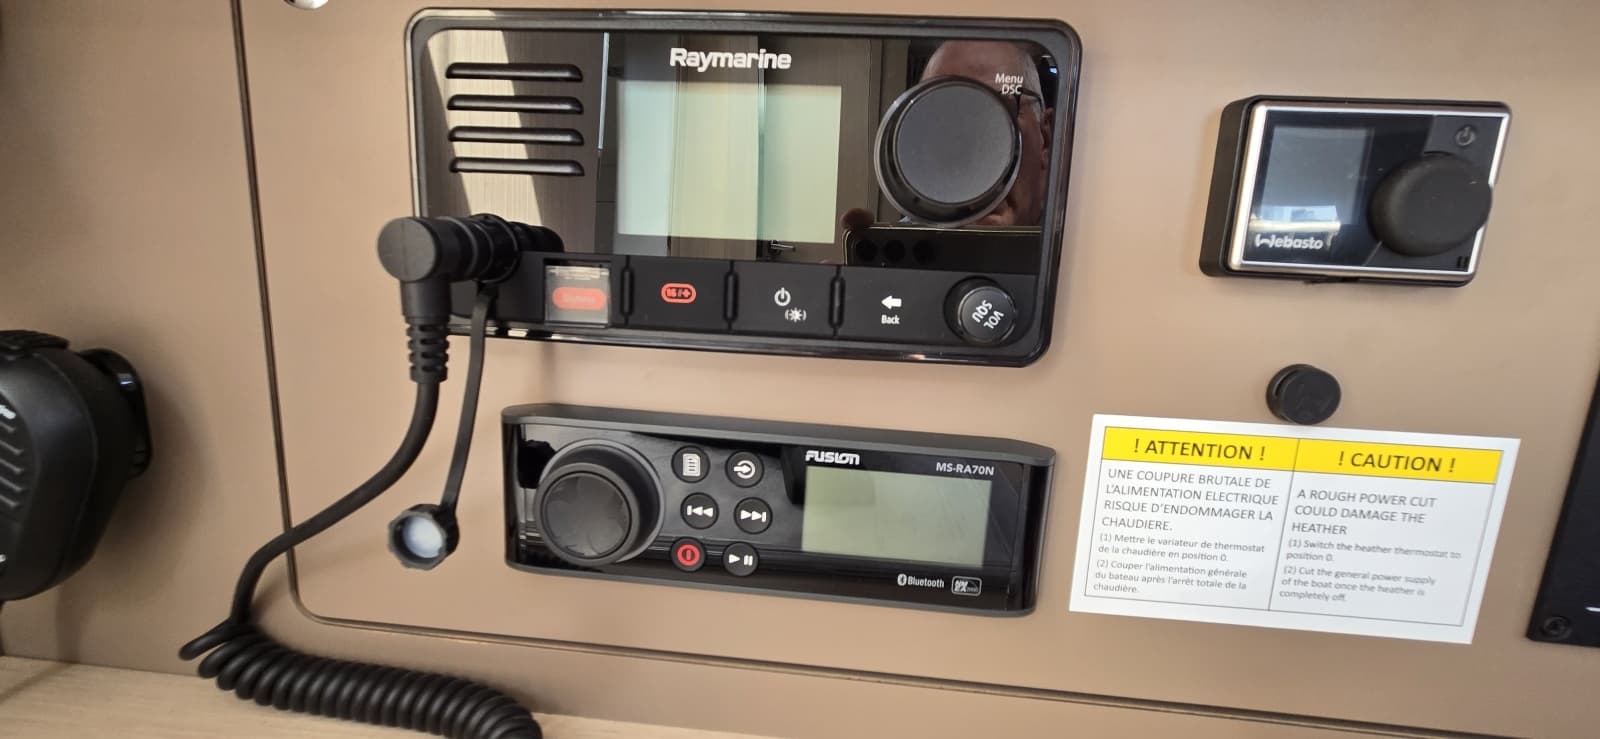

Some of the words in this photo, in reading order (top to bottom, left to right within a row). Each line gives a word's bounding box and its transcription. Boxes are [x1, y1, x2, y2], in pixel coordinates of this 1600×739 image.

[670, 47, 792, 72] Raymarine
[995, 73, 1024, 84] Menu
[1002, 84, 1022, 94] DSC
[1255, 234, 1323, 249] Webasto
[881, 314, 900, 324] Back
[972, 300, 993, 323] SQU
[984, 310, 1005, 329] VOL
[805, 450, 860, 465] FUSION
[1134, 438, 1139, 453] !
[1145, 440, 1253, 460] ATTENTION
[1259, 446, 1266, 461] !
[936, 462, 994, 476] MS-RA70N
[1338, 451, 1345, 466] !
[1350, 452, 1442, 472] CAUTION
[1448, 458, 1456, 473] !
[1108, 469, 1132, 479] UNE
[1137, 470, 1195, 483] COUPURE
[1199, 474, 1251, 487] BRUTALE
[1255, 478, 1271, 488] DE
[1106, 484, 1202, 500] L'ALIMENTATION
[1205, 491, 1279, 506] ELECTRIQUE
[1297, 489, 1306, 498] A
[1310, 490, 1356, 502] ROUGH
[1359, 493, 1406, 506] POWER
[1409, 496, 1437, 508] CUT
[1104, 500, 1147, 513] RISQUE
[1151, 503, 1256, 519] D'ENDOMMAGER
[1259, 511, 1273, 521] LA
[1295, 505, 1337, 518] COULD
[1341, 508, 1397, 521] DAMAGE
[1402, 512, 1426, 524] THE
[1102, 517, 1173, 531] CHAUDIERE.
[1291, 522, 1347, 535] HEATHER
[1100, 533, 1112, 542] (1)
[1114, 534, 1145, 544] Mettre
[1148, 537, 1155, 545] le
[1158, 538, 1198, 548] variateur
[1215, 542, 1265, 552] thermostat
[1289, 539, 1301, 548] (1)
[1304, 540, 1334, 550] Switch
[1337, 542, 1352, 551] the
[1354, 544, 1392, 554] heather
[1394, 547, 1448, 558] thermostat
[1122, 546, 1166, 558] chaudière
[1182, 551, 1218, 561] position
[1286, 552, 1324, 562] position
[1097, 560, 1109, 568] (2)
[1111, 560, 1143, 571] Couper
[1208, 568, 1247, 578] générale
[1284, 566, 1297, 575] (2)
[1299, 566, 1315, 576] Cut
[1317, 568, 1333, 577] the
[1334, 570, 1370, 580] general
[1371, 573, 1402, 583] power
[1404, 576, 1436, 586] supply
[908, 576, 944, 588] Bluetooth
[1093, 583, 1139, 593] chaudière.
[1109, 572, 1139, 582] bateau
[1142, 574, 1165, 586] après
[1196, 579, 1222, 588] totale
[1225, 580, 1237, 589] de
[1239, 582, 1247, 590] la
[1293, 579, 1309, 587] the
[1312, 580, 1332, 589] boat
[1360, 584, 1375, 592] the
[1377, 585, 1415, 595] heather
[1279, 590, 1329, 602] completely
